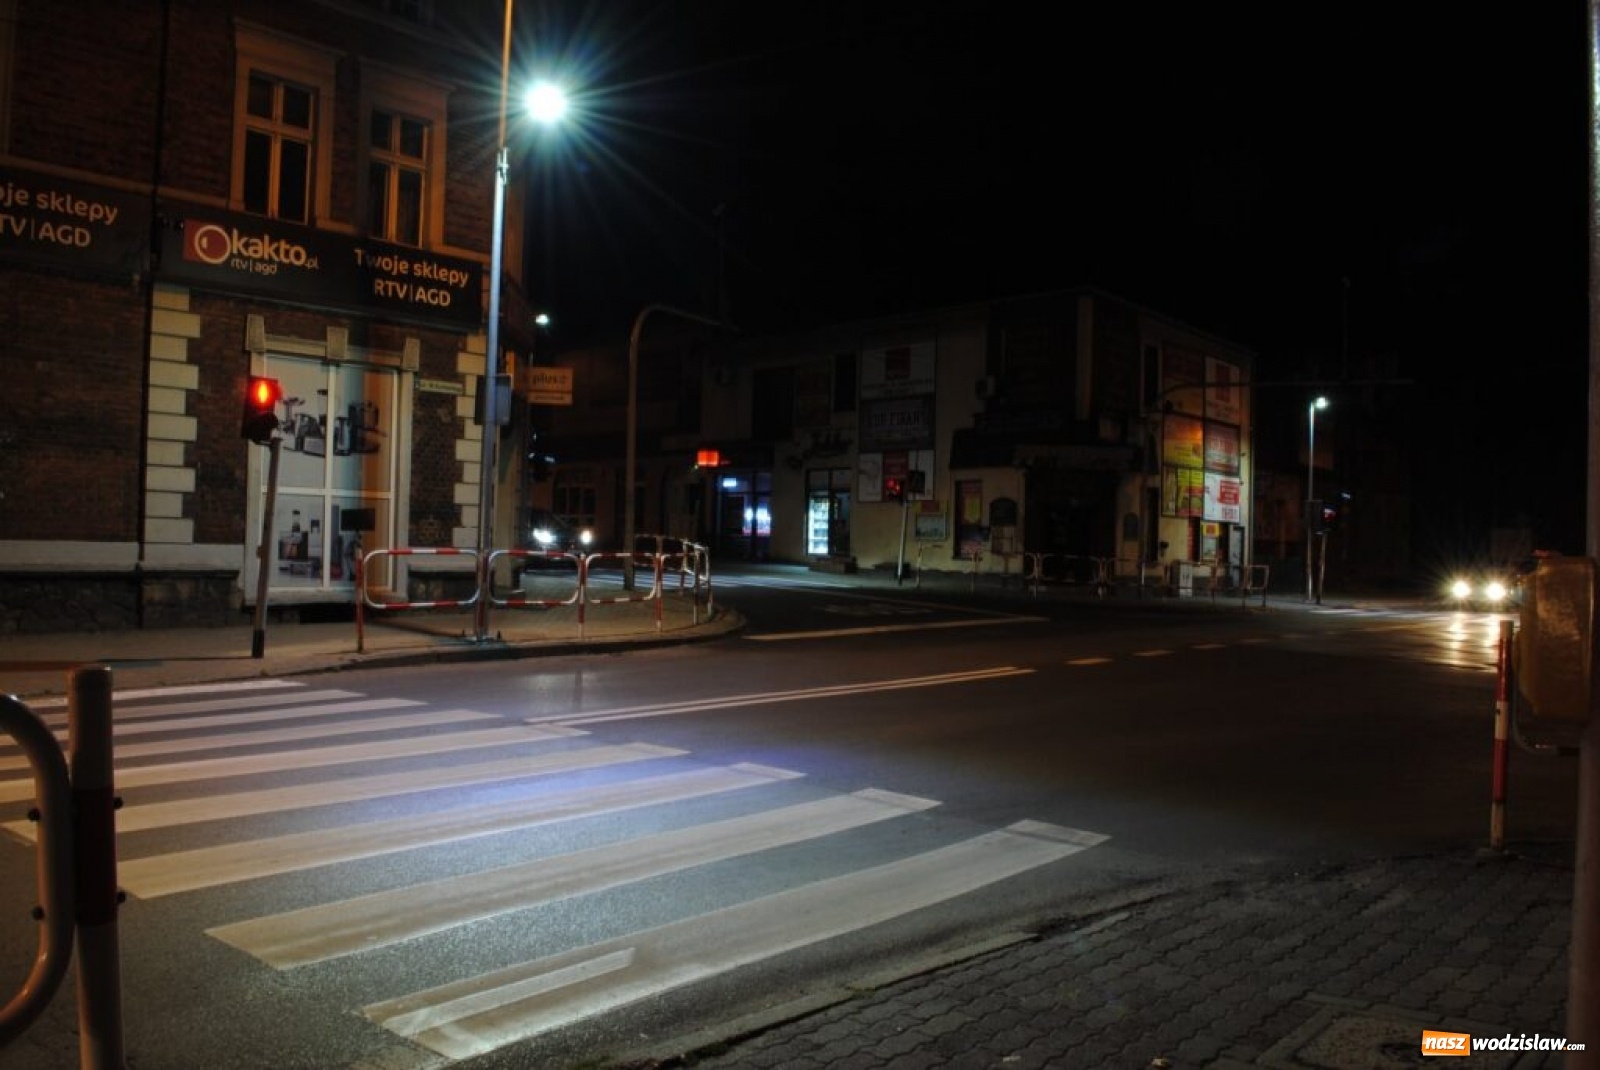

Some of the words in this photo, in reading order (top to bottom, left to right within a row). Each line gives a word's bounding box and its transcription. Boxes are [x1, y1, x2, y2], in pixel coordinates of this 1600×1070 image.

[35, 190, 119, 226] sklepy
[353, 248, 409, 276] Twoje
[413, 260, 470, 289] sklepy
